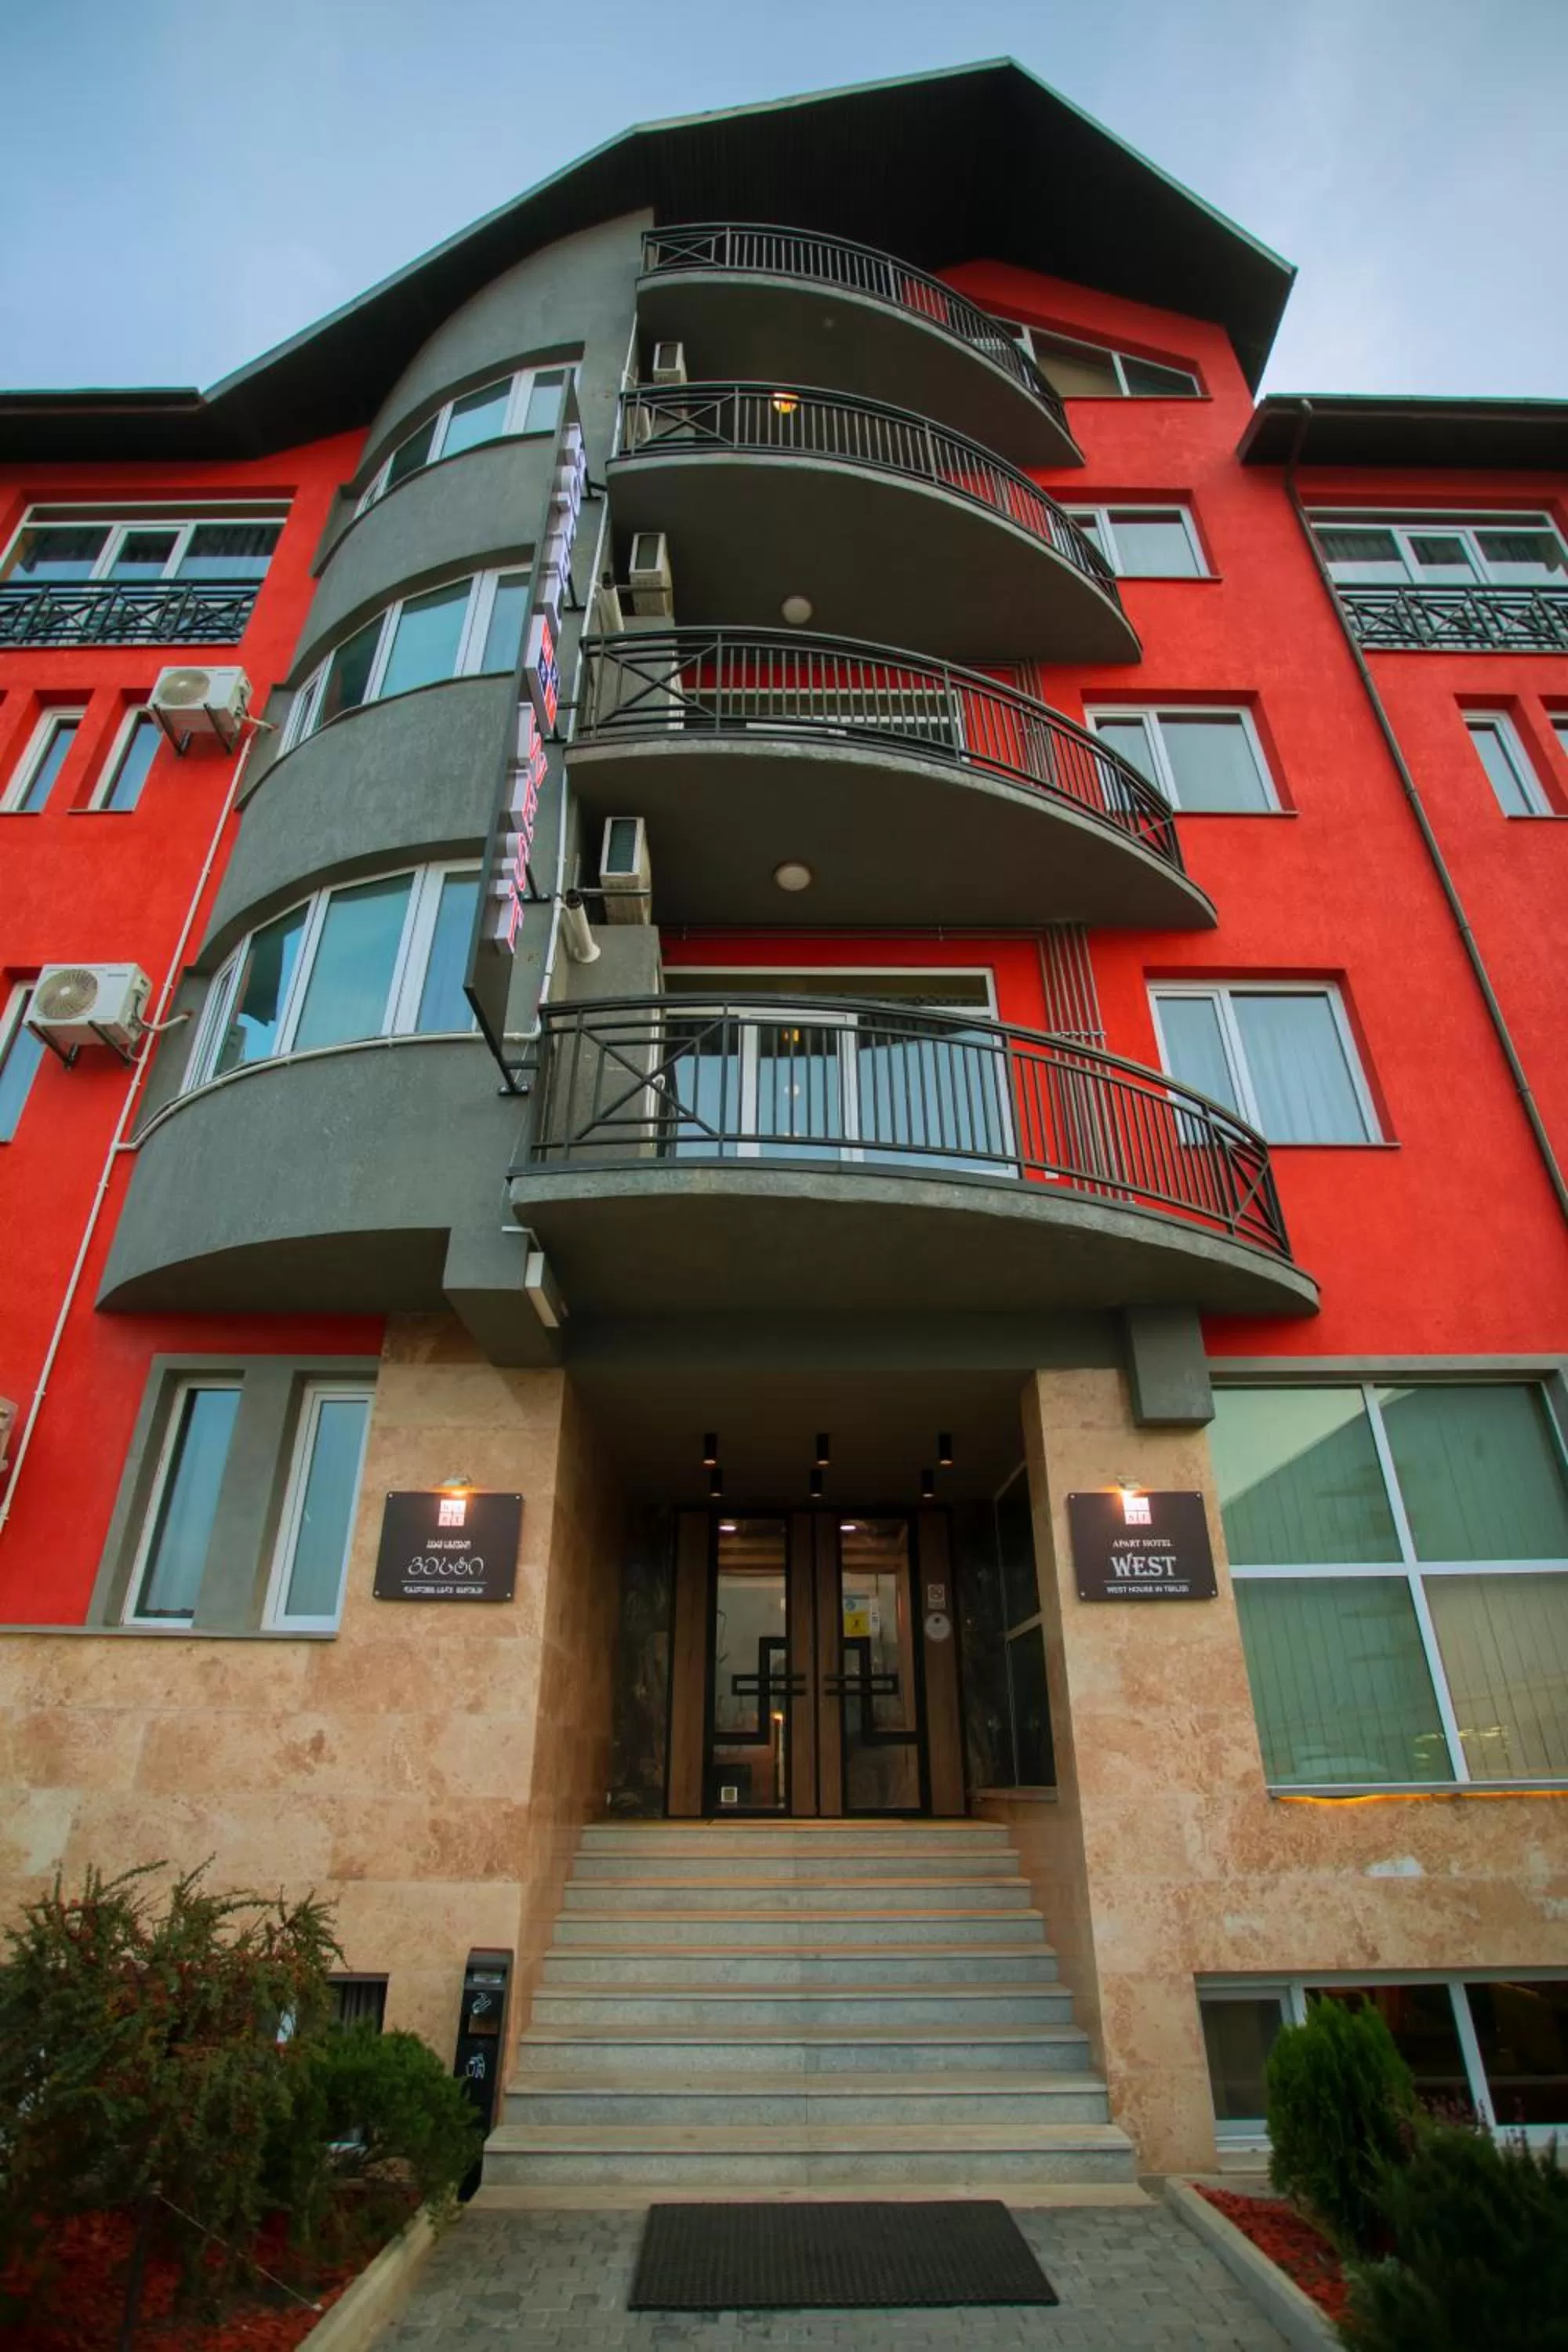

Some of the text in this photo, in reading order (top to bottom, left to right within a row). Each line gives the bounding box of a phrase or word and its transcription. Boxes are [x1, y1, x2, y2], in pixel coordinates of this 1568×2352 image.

[503, 703, 548, 953] WEST
[1112, 1539, 1140, 1548] APART
[1110, 1552, 1177, 1577] WEST
